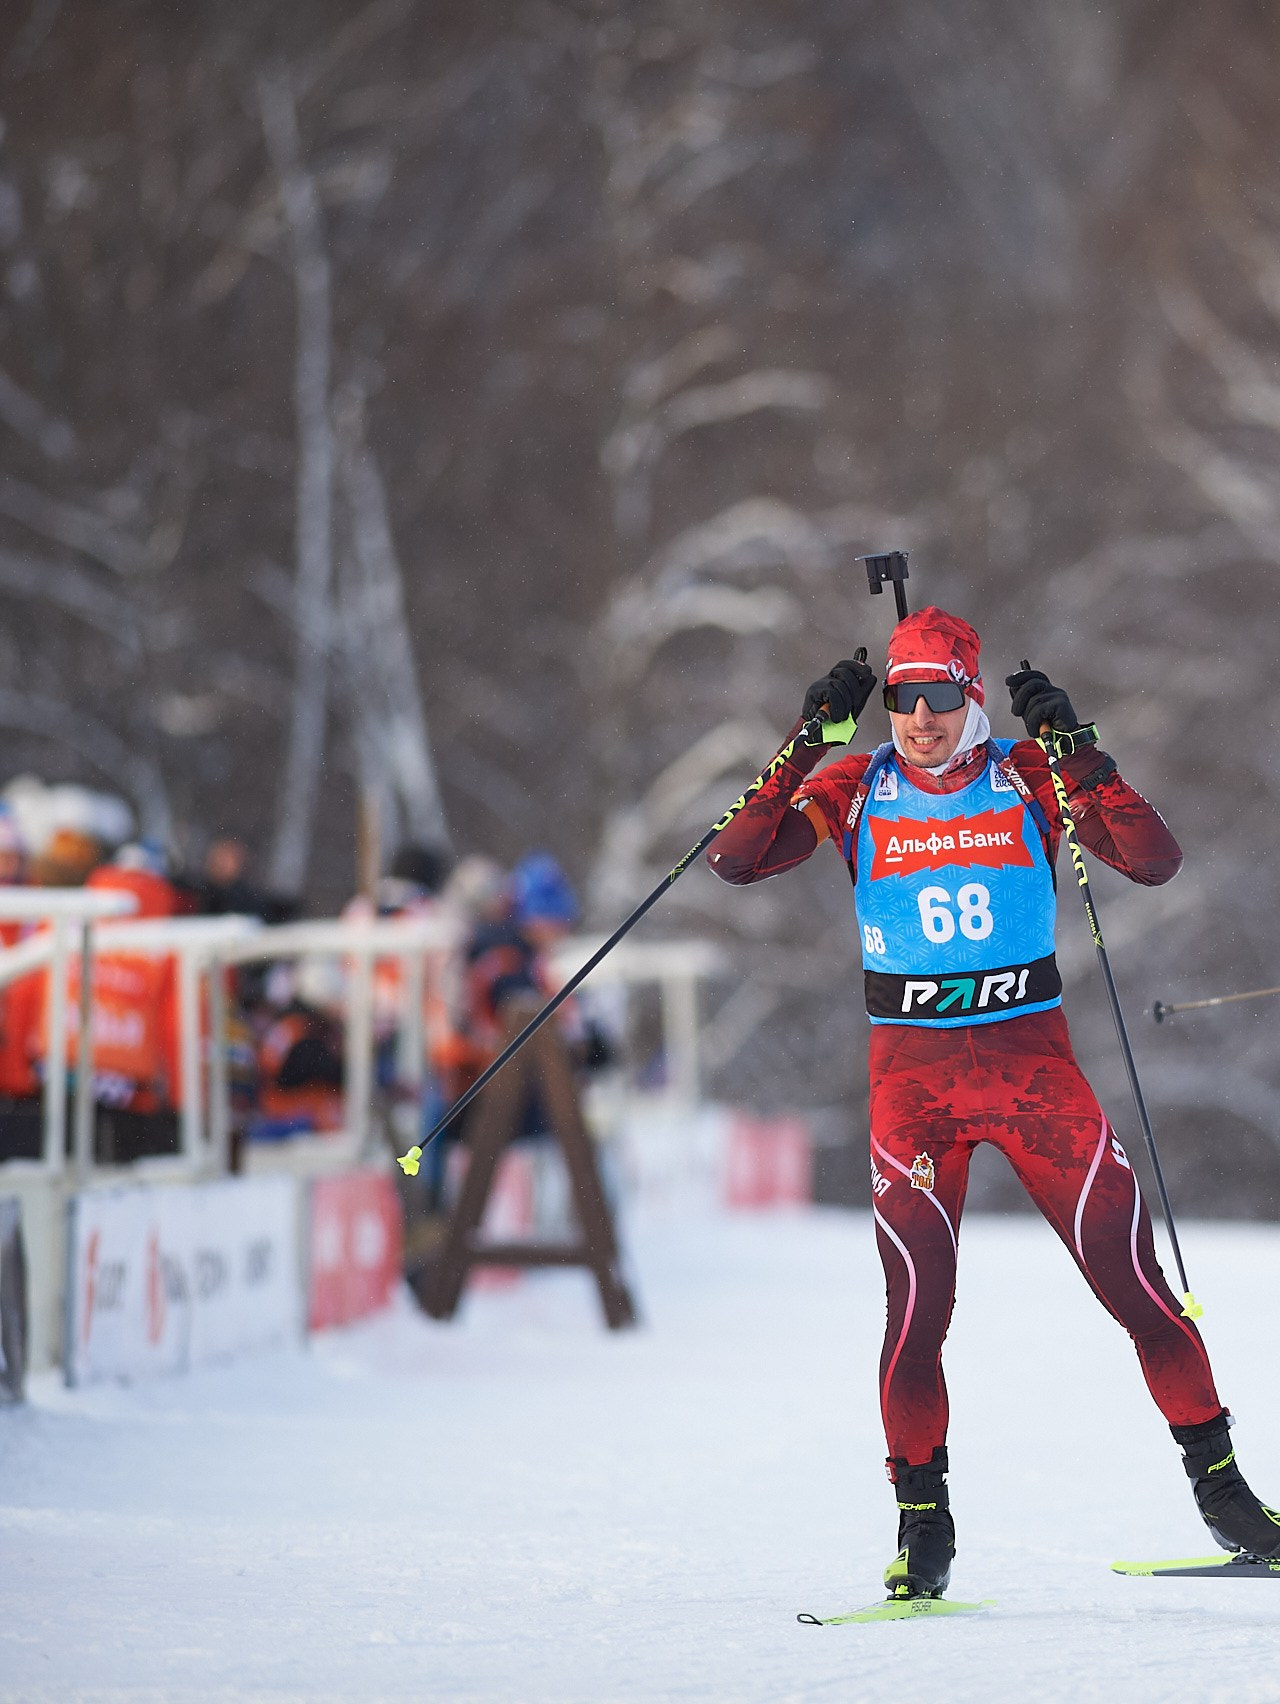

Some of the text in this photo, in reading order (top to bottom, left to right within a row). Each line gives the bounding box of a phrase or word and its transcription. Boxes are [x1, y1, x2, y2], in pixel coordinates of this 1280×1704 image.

[886, 830, 1014, 862] Альфа Банк
[917, 883, 994, 943] 68
[863, 924, 886, 954] 68
[901, 968, 1030, 1013] PARI
